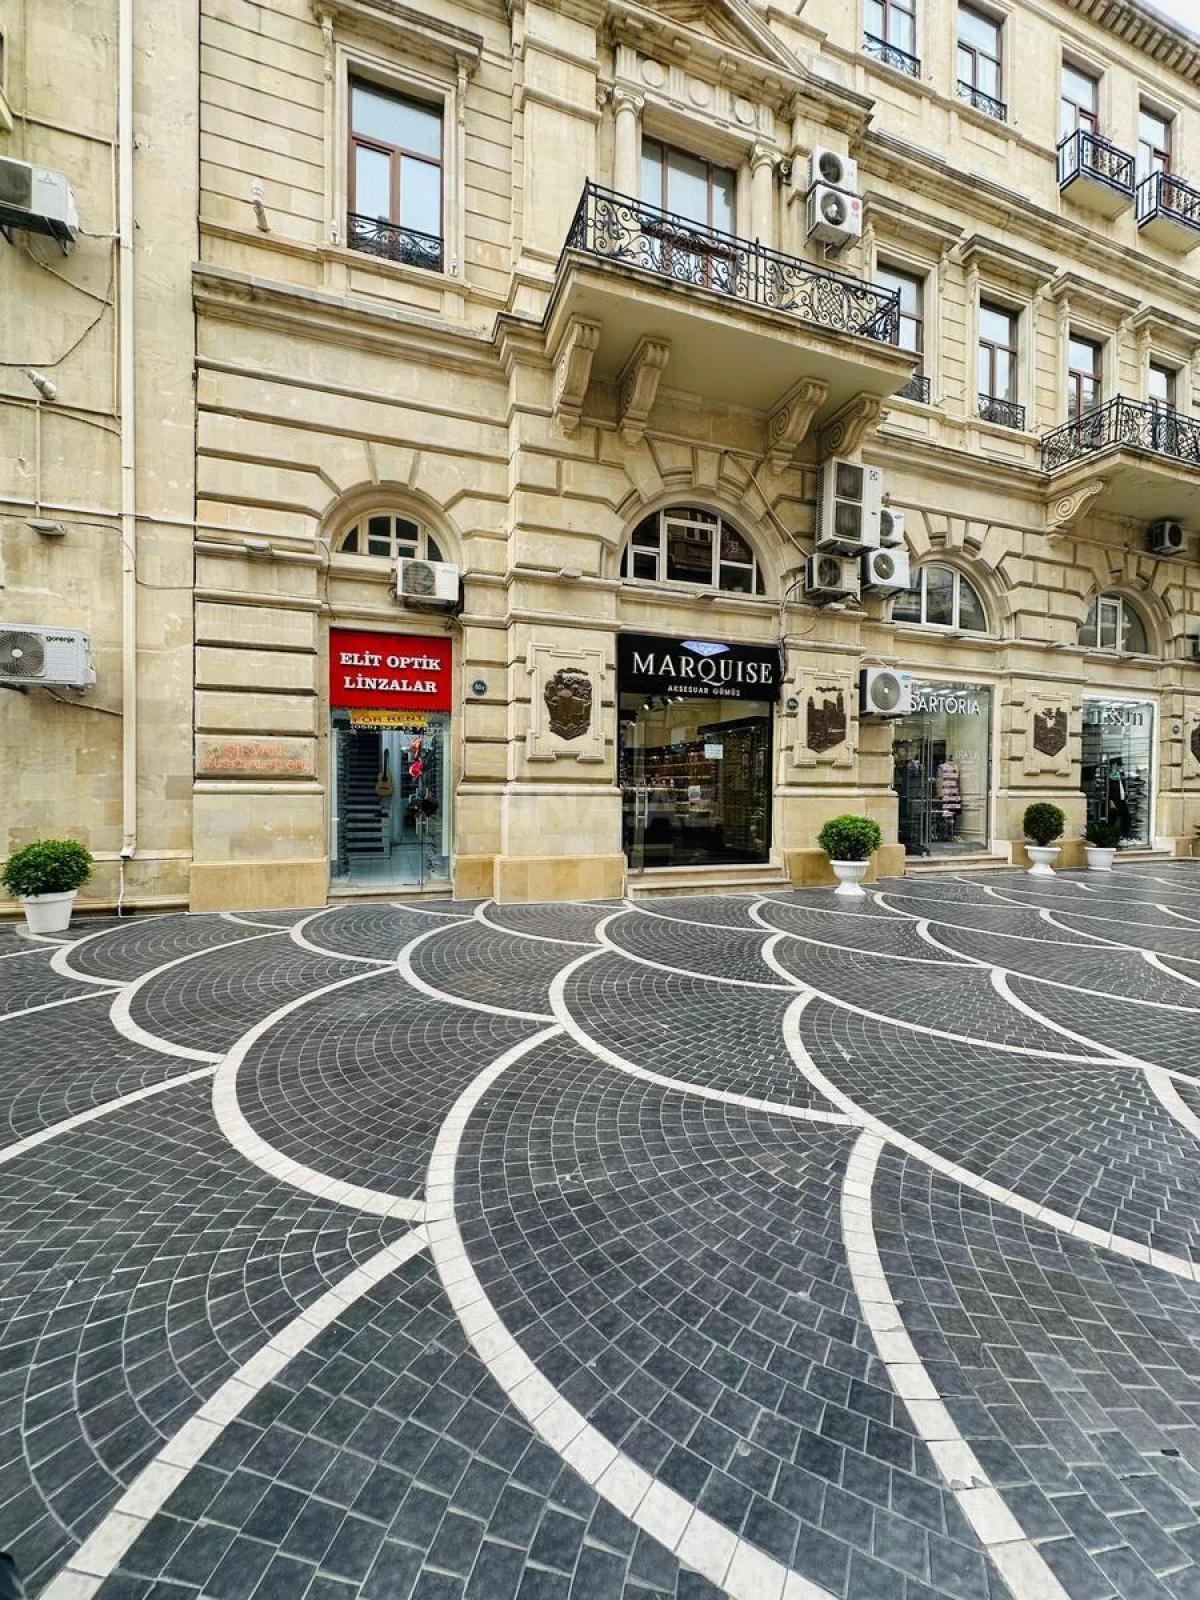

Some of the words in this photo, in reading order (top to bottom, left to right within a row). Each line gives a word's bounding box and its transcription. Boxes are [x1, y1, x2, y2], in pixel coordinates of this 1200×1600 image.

[340, 650, 382, 667] ELİT
[386, 655, 441, 670] OPTİK
[631, 652, 773, 686] MARQUISE
[343, 673, 438, 693] LİNZALAR
[668, 685, 709, 694] AKSESUAR
